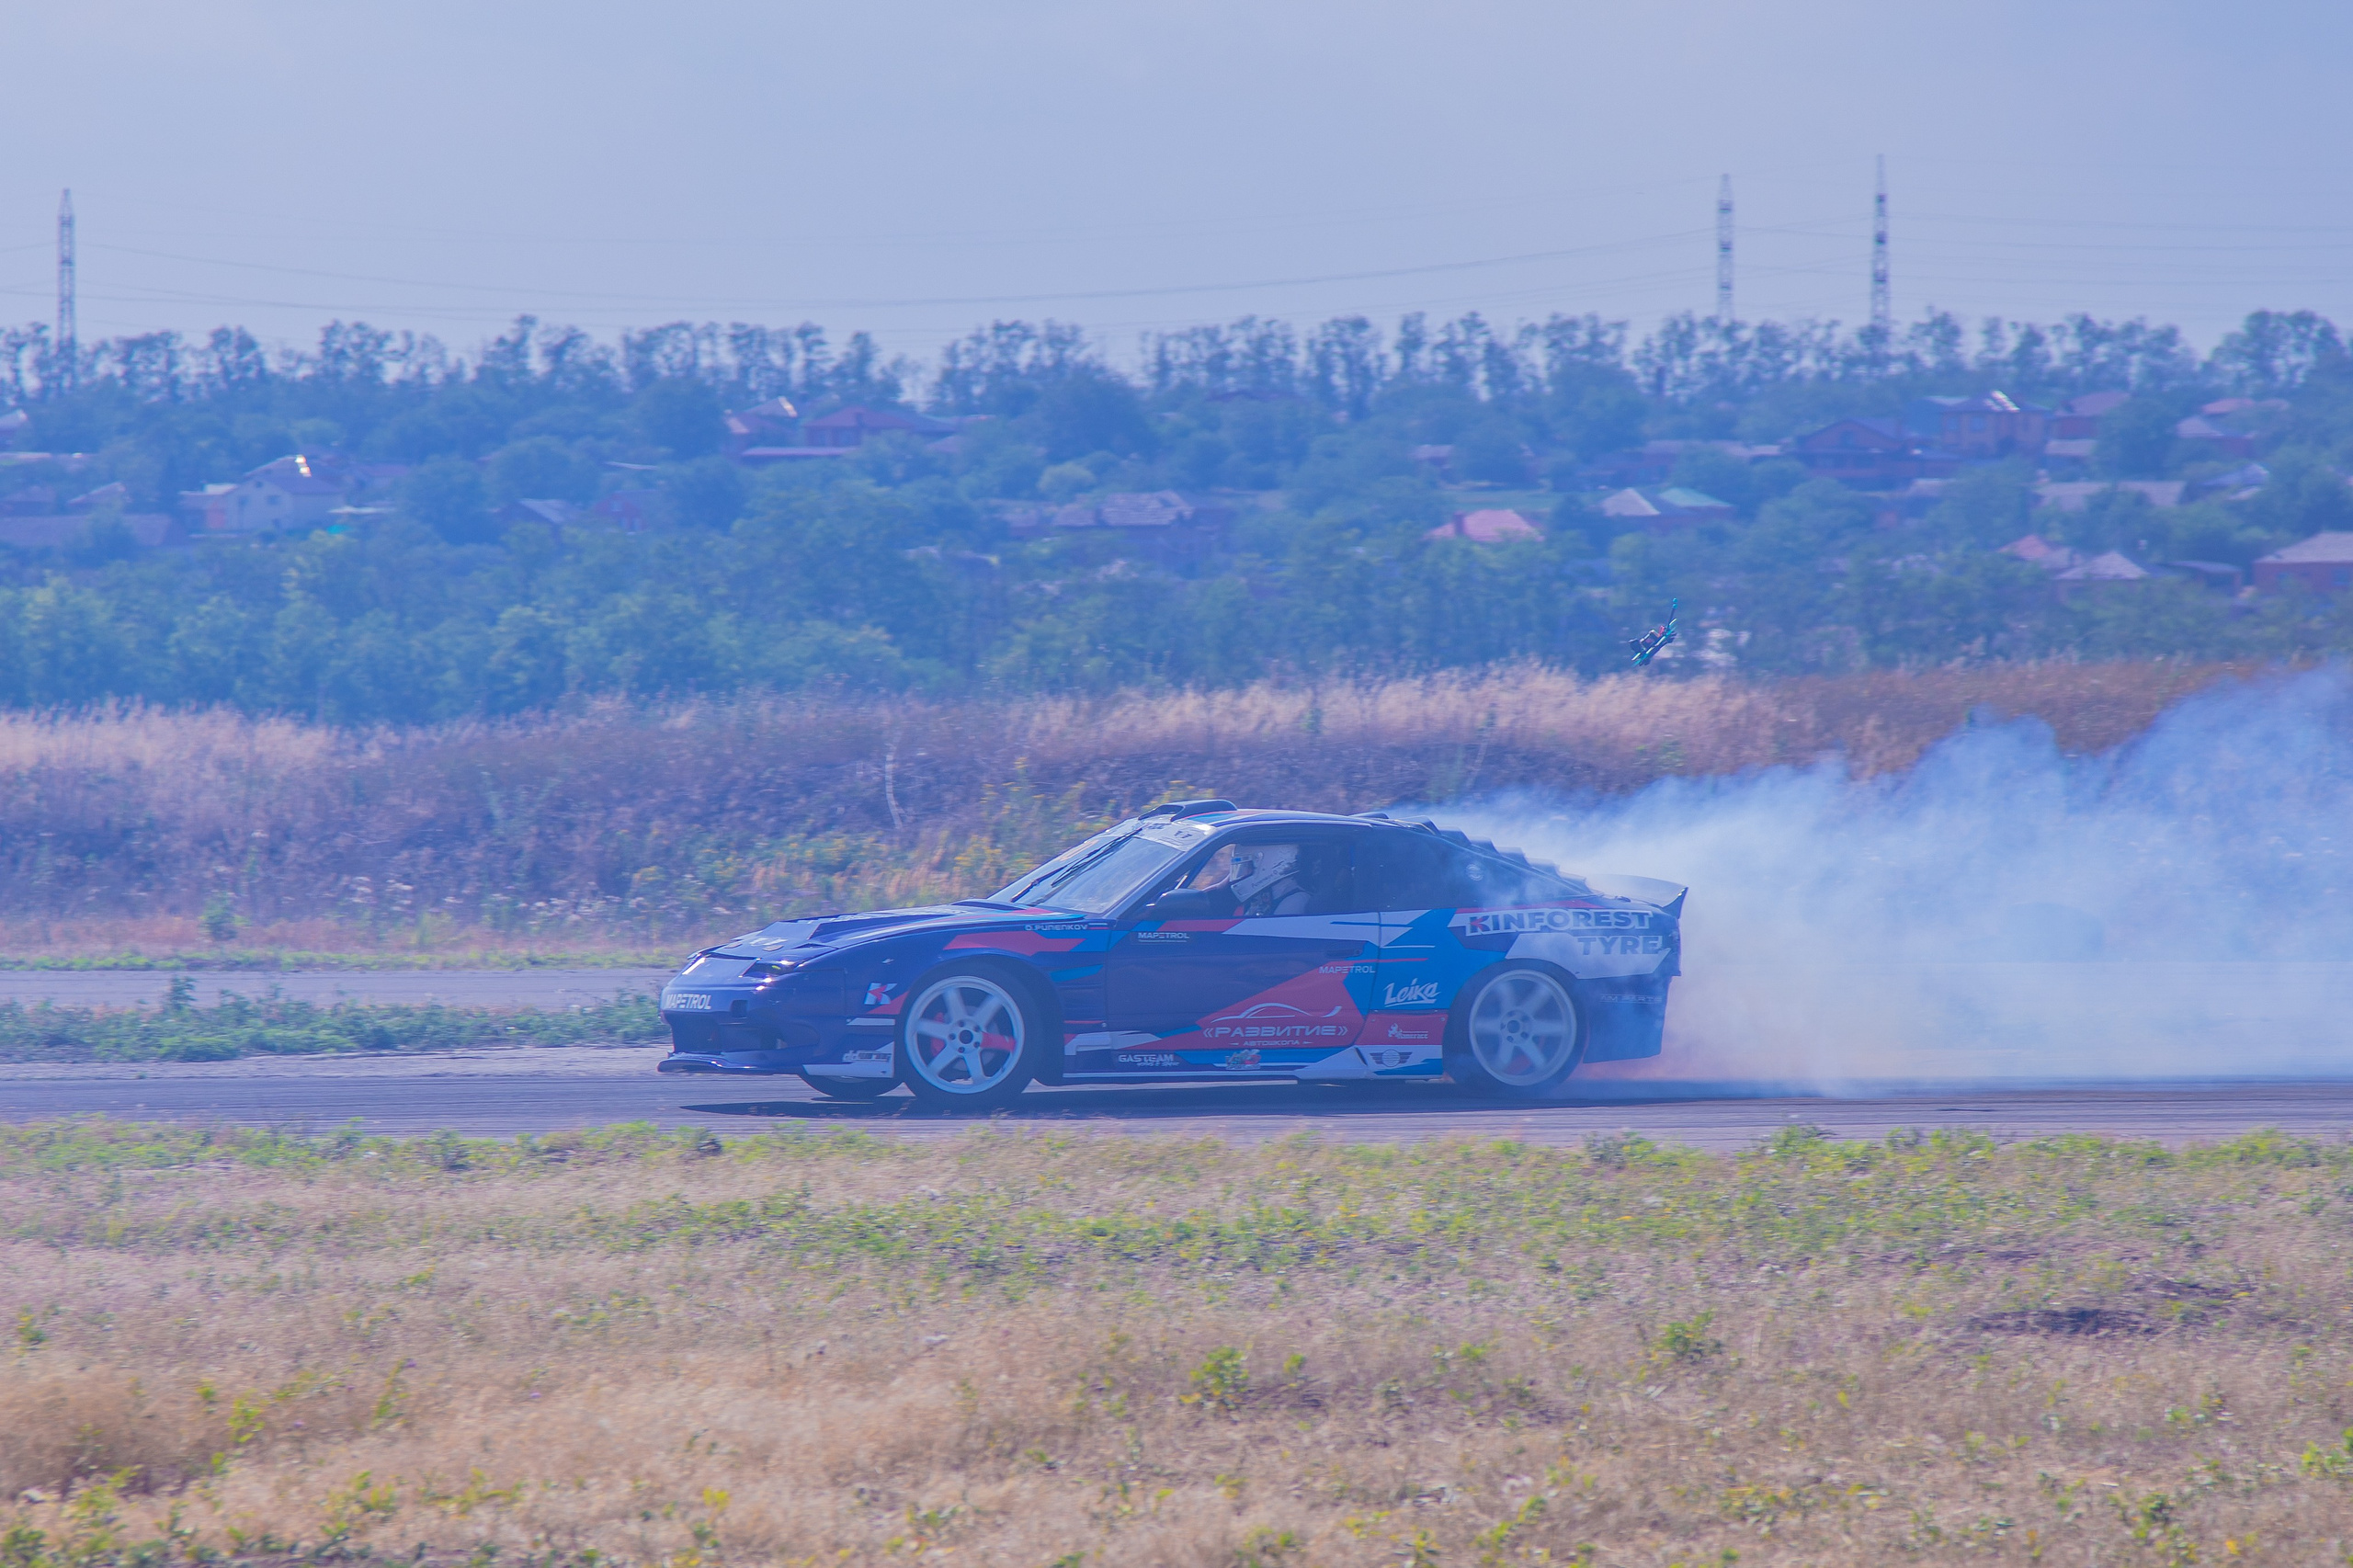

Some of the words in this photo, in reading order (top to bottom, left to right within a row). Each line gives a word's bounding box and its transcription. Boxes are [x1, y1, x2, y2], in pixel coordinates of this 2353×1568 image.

[1468, 911, 1652, 934] KINFOREST
[1577, 936, 1662, 956] TYRE
[1318, 965, 1376, 974] MAPETROL
